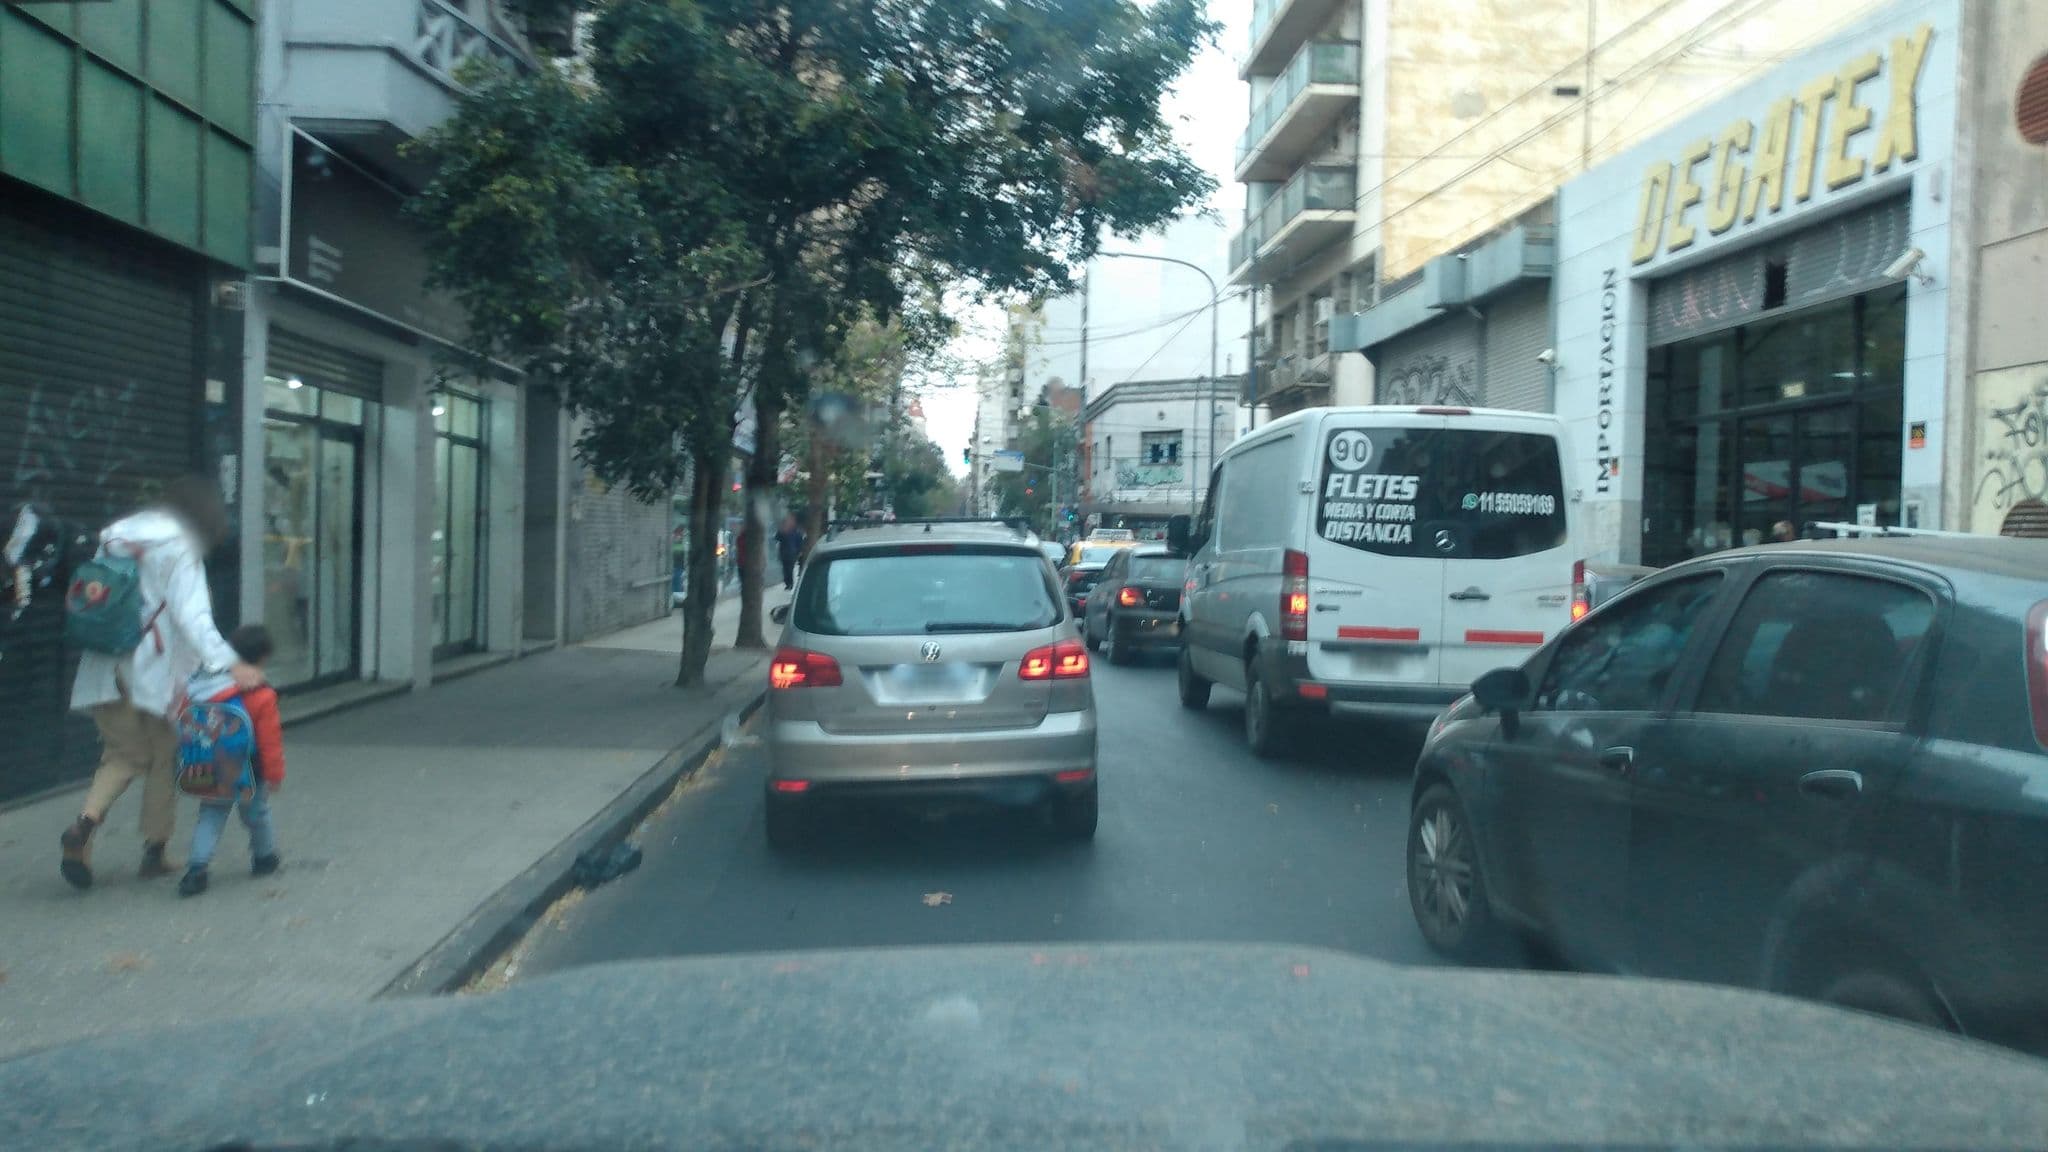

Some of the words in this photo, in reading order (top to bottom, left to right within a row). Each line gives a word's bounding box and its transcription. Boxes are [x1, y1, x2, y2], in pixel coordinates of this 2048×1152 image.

[1631, 22, 1935, 267] DEGATEX
[1334, 437, 1367, 462] 90
[1325, 473, 1420, 501] FLETES
[1323, 502, 1365, 520] MEDIA
[1366, 503, 1376, 520] Y
[1375, 504, 1416, 521] CORTA
[1324, 521, 1413, 545] DISTANCIA
